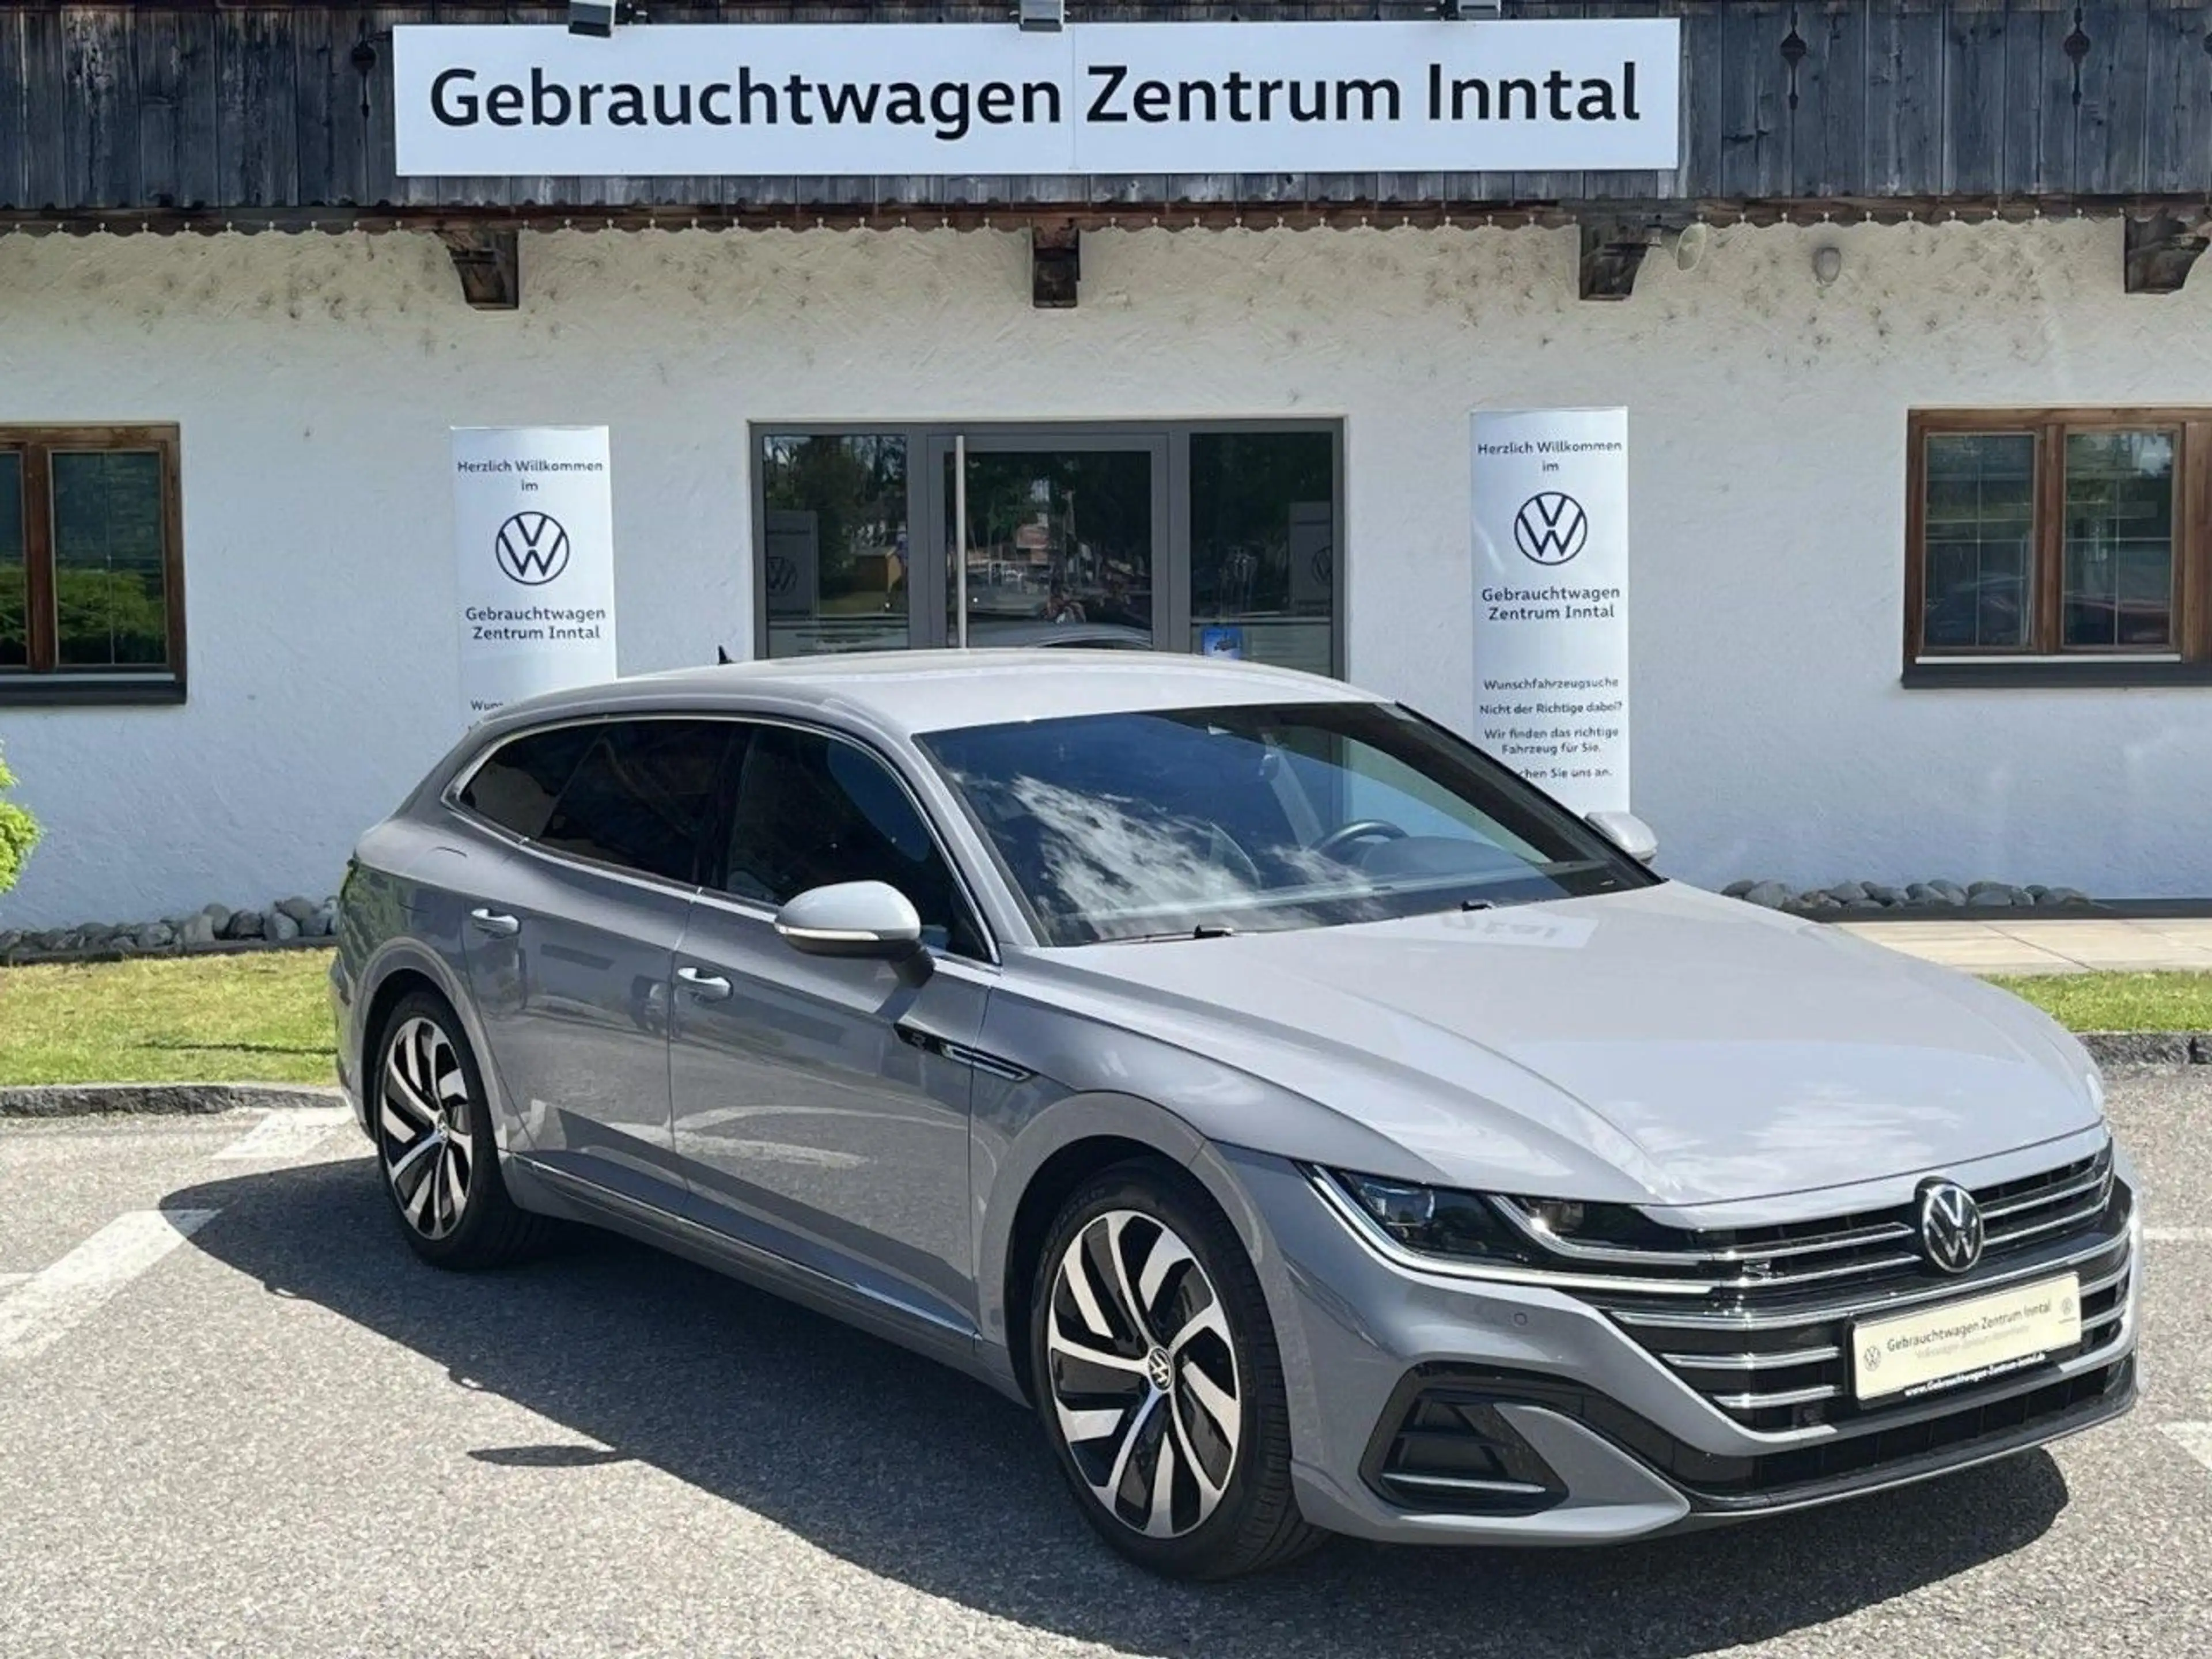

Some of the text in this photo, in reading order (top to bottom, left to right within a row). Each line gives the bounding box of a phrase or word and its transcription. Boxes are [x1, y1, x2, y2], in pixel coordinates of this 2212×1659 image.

[429, 62, 1640, 140] Gebrauchtwagen Zentrum Inntal
[1478, 441, 1622, 455] Herzlich Willkommen
[457, 460, 603, 473] Herzlich Willkommen
[1542, 461, 1559, 472] im
[521, 479, 539, 491] im
[1482, 586, 1620, 602] Gebrauchtwagen
[465, 607, 606, 624] Gebrauchtwagen
[1488, 605, 1615, 620] Zentrum Inntal
[472, 625, 600, 640] Zentrum Inntal
[1483, 677, 1619, 690] Wunschfahrzeugsuche
[1479, 700, 1622, 715] Nicht der Richtige dabei?
[1484, 726, 1619, 739] Wir finden das richtige
[1501, 744, 1558, 756] Fahrzeug
[1561, 743, 1578, 753] für
[1519, 768, 1547, 778] chen
[1550, 768, 1568, 778] Sie
[1571, 769, 1591, 778] uns
[1887, 1321, 1979, 1351] Gebrauchtwagen
[1981, 1310, 2022, 1330] Zentrum
